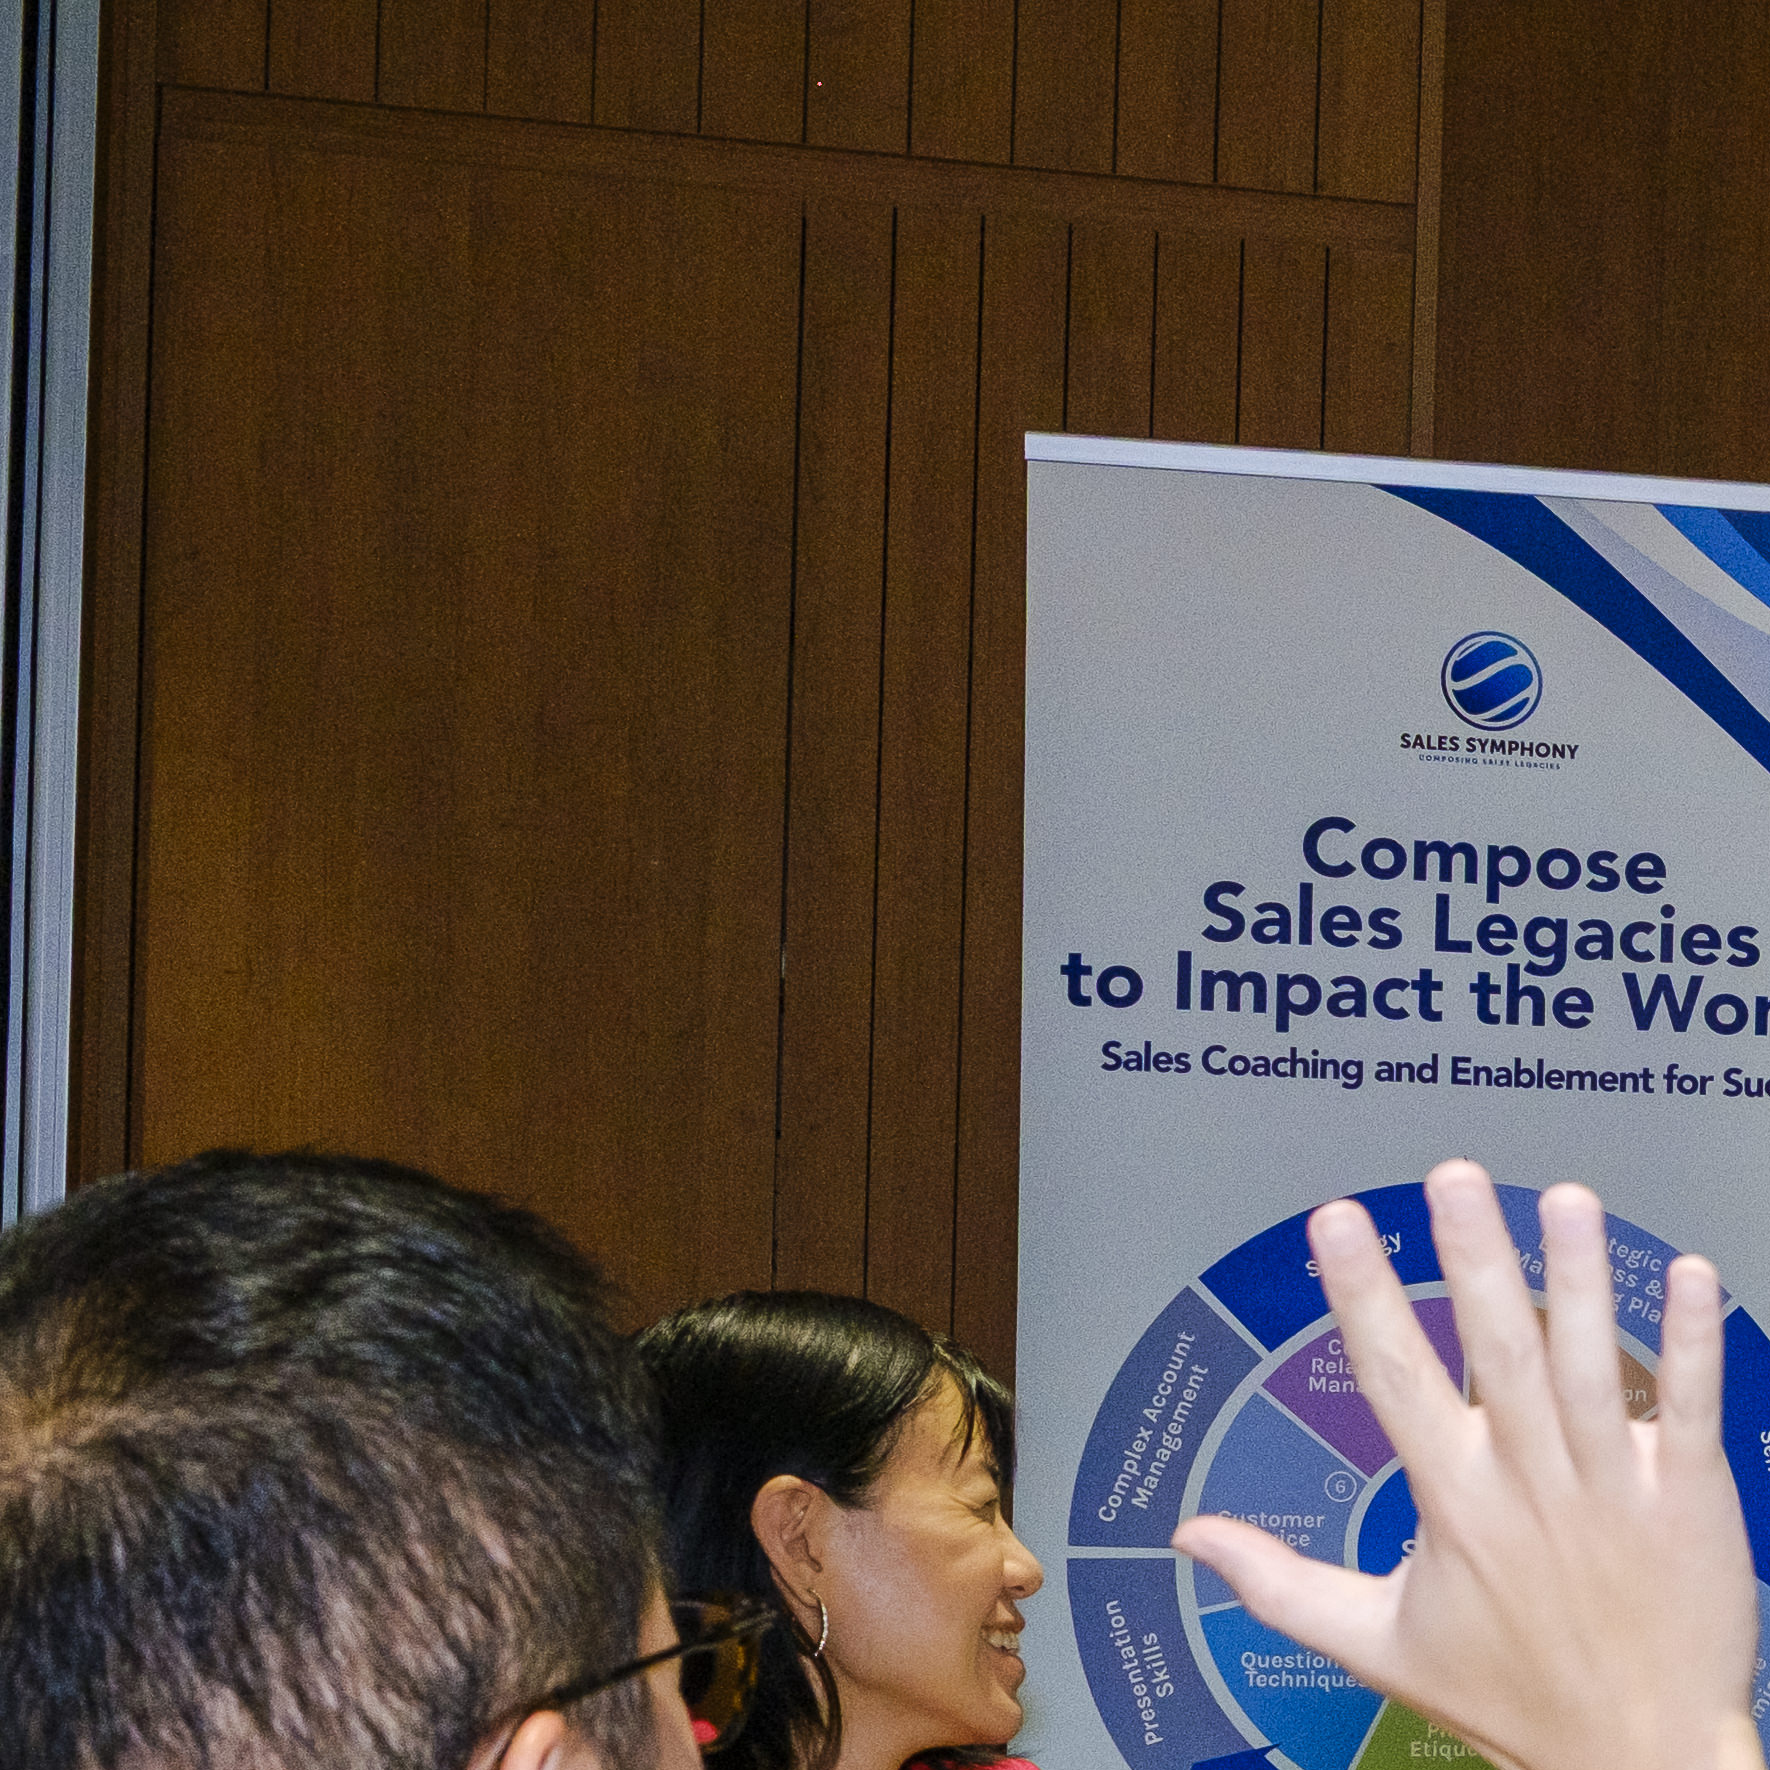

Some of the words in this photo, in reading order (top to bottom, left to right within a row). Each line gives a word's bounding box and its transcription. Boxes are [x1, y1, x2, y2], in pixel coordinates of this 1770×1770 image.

[1400, 733, 1460, 751] SALES
[1466, 737, 1579, 759] SYMPHONY
[1301, 816, 1668, 903] Compose
[1201, 880, 1402, 951] Sales
[1433, 893, 1761, 977] Legacies
[1060, 951, 1144, 1010] to
[1176, 951, 1443, 1032] Impact
[1470, 964, 1595, 1030] the
[1101, 1042, 1191, 1075] Sales
[1202, 1045, 1363, 1088] Coaching
[1374, 1050, 1438, 1083] and
[1450, 1056, 1655, 1094] Enablement
[1662, 1062, 1715, 1097] for
[1628, 1296, 1662, 1324] Pla
[1645, 1279, 1664, 1300] &
[1099, 1426, 1153, 1522] Complex
[1142, 1331, 1195, 1423] Account
[1131, 1364, 1209, 1509] Management
[1218, 1510, 1325, 1528] stomer
[1106, 1600, 1164, 1746] Presentation
[1142, 1632, 1175, 1698] Skills
[1241, 1651, 1340, 1670] Question
